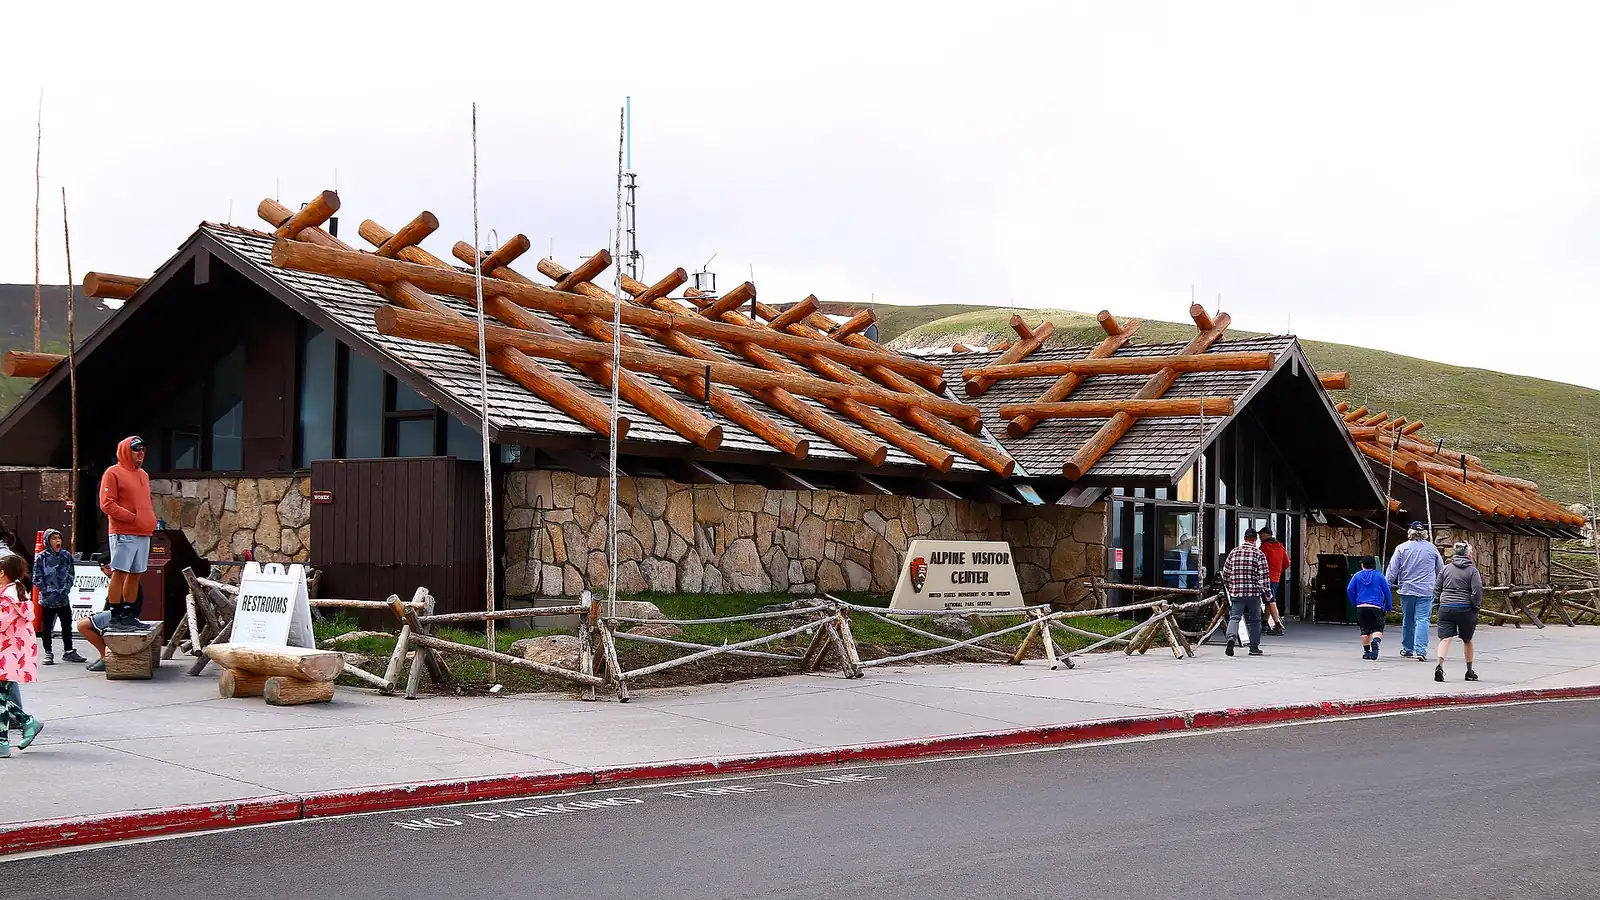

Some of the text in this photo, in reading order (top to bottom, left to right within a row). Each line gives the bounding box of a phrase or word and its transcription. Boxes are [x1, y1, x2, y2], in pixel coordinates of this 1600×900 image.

[929, 552, 1010, 565] ALPINE VISITOR
[73, 575, 109, 588] ESTROOMS
[951, 571, 989, 584] CENTER
[241, 594, 289, 614] RESTROOMS
[390, 817, 464, 831] NO
[463, 797, 645, 822] PARKING
